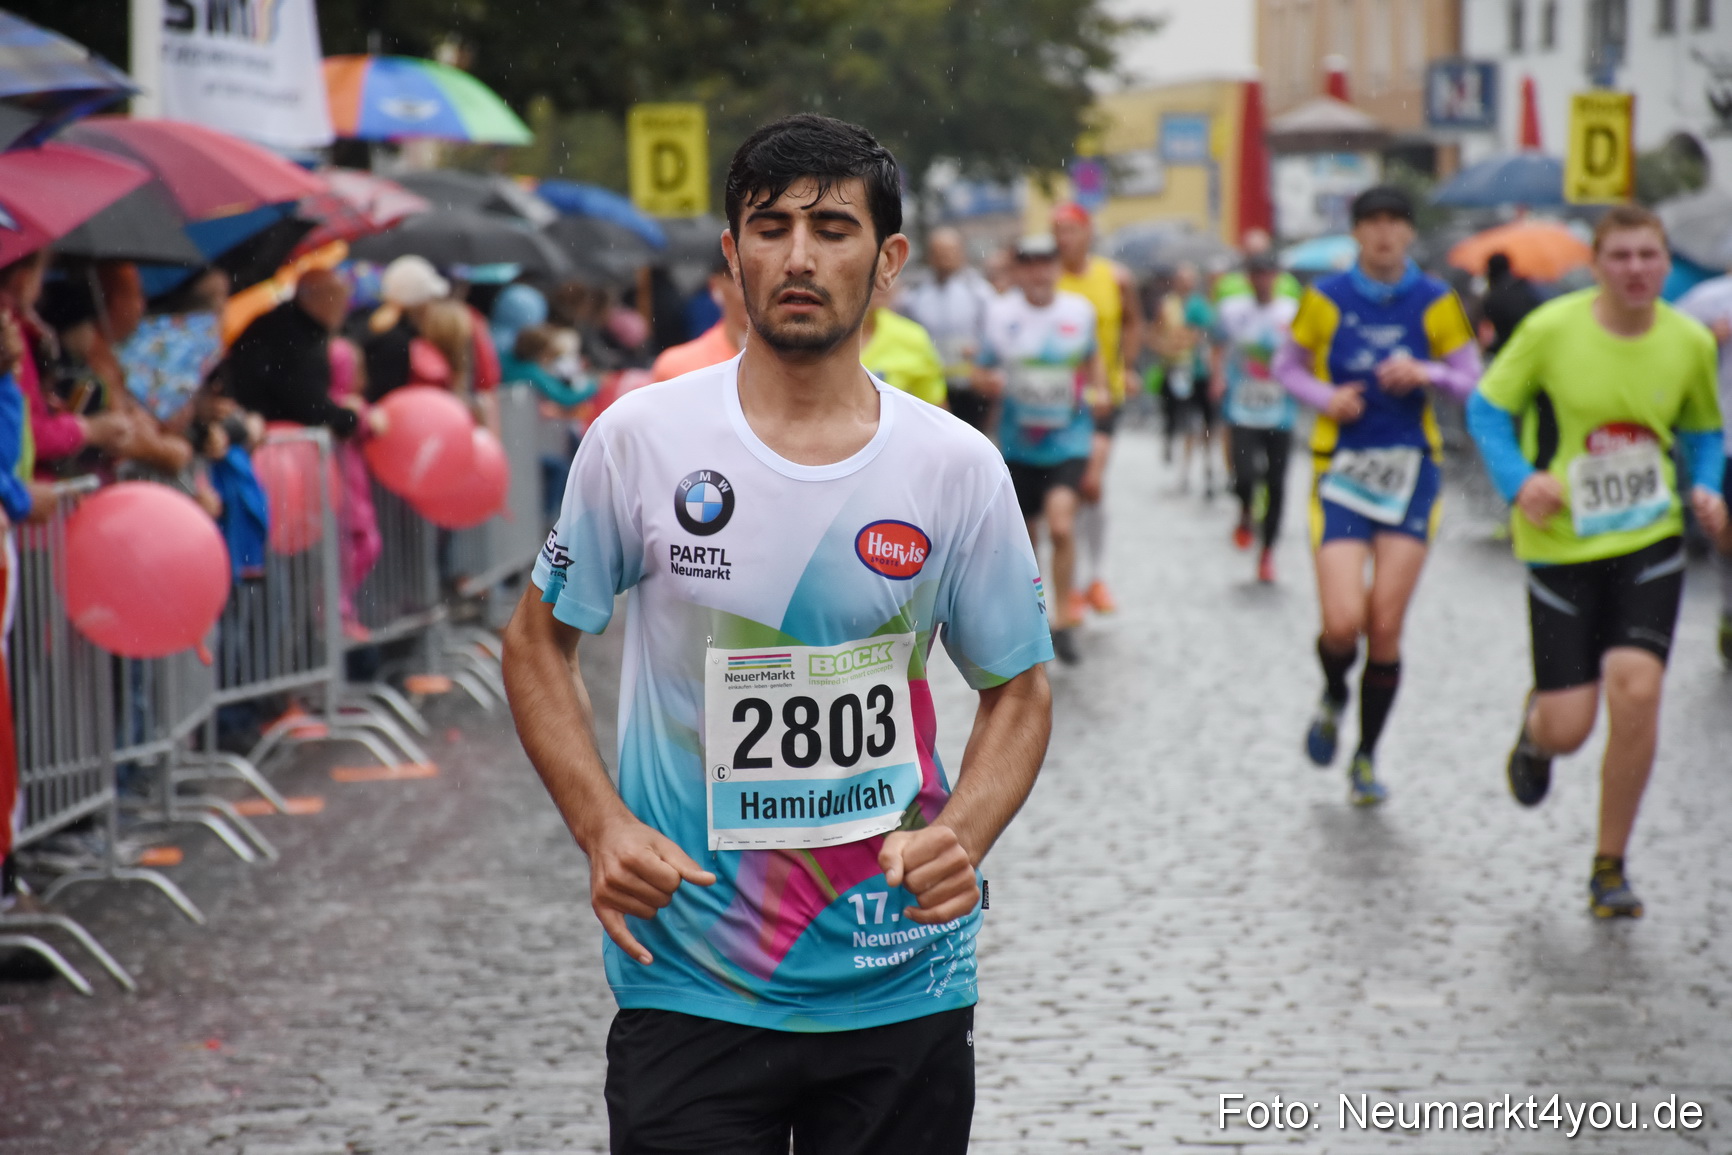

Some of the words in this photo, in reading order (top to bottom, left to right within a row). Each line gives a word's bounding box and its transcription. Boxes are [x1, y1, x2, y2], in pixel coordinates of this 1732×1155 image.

[650, 139, 688, 194] D
[1584, 123, 1618, 178] D
[680, 471, 731, 494] BMW
[669, 544, 732, 567] PARTL
[867, 531, 925, 566] Hervis
[670, 562, 731, 581] Neumarkt
[808, 640, 895, 677] BOCK
[808, 677, 841, 686] inspired
[850, 670, 866, 680] smart
[866, 663, 894, 676] concepts
[724, 669, 796, 683] NeuerMarkt
[732, 684, 897, 770] 2803
[740, 778, 896, 821] Hamidullah
[847, 891, 900, 925] 17.
